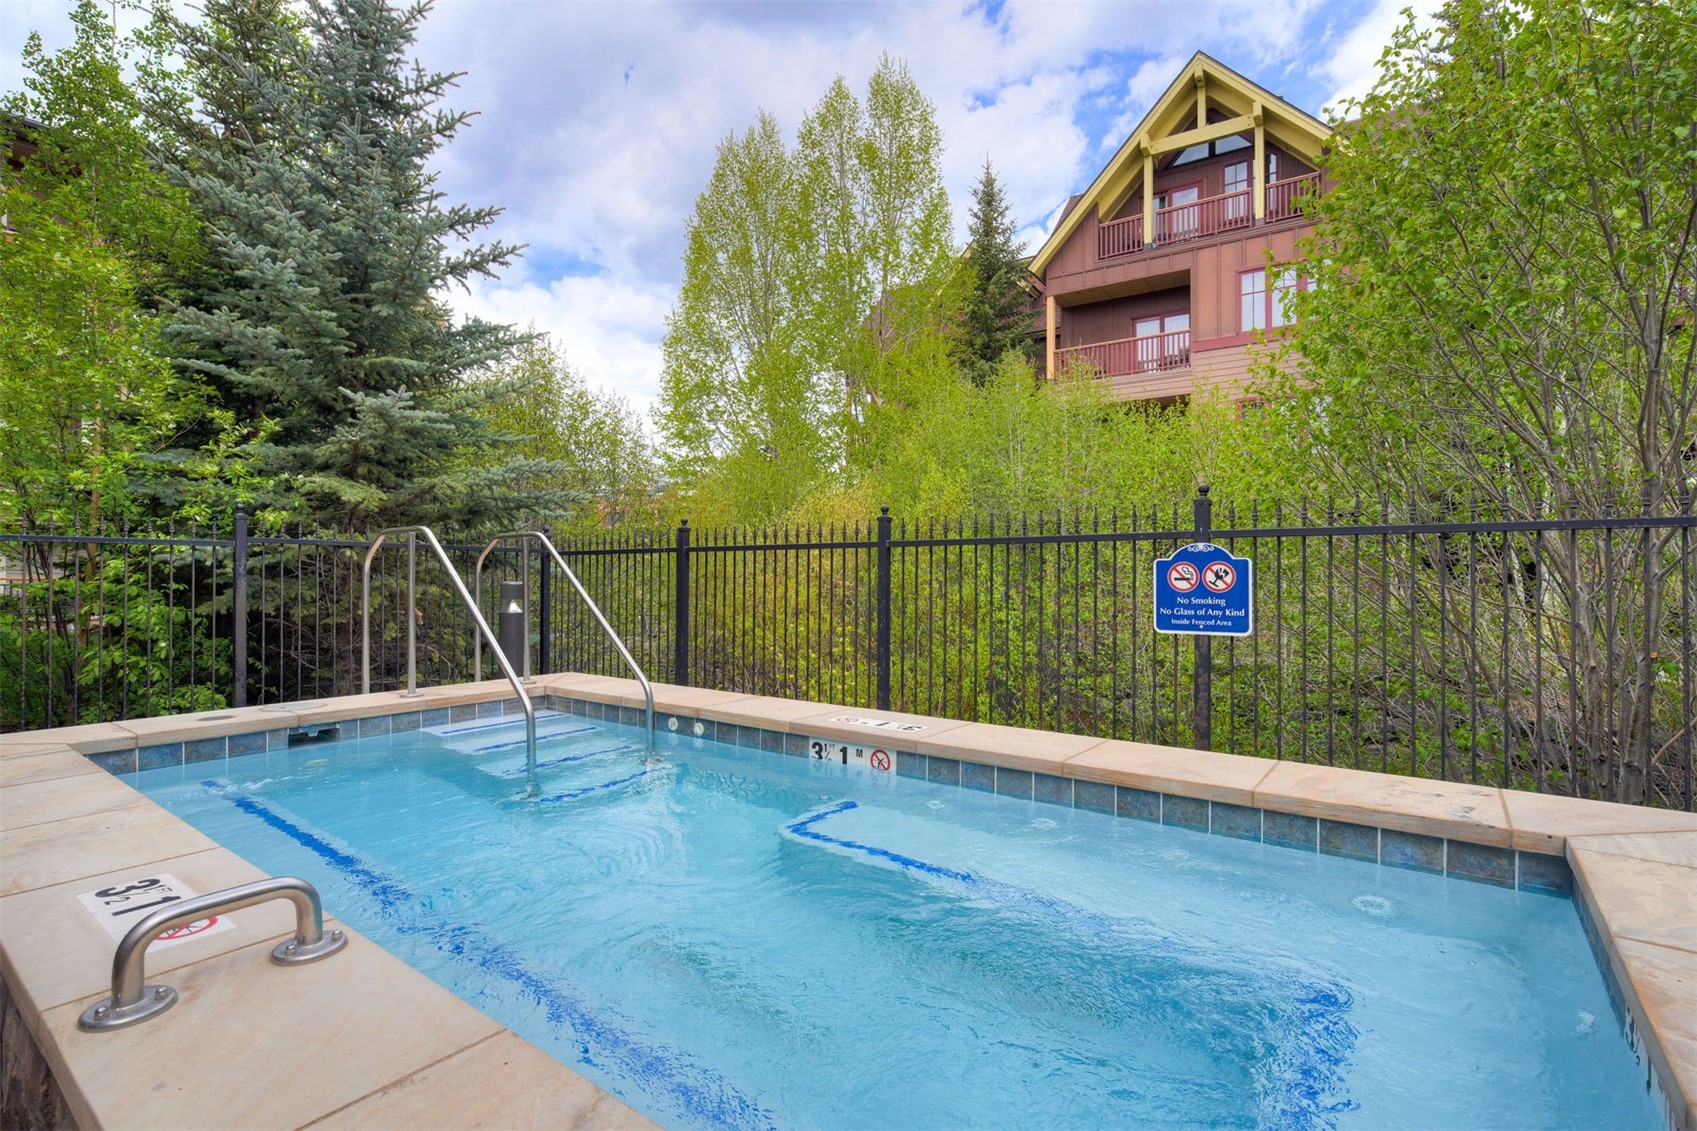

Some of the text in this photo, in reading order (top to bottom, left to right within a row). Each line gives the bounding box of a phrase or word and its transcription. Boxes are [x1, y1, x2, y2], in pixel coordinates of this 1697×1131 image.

[1191, 597, 1226, 606] Smoking
[1207, 608, 1223, 618] Any
[856, 748, 863, 758] M
